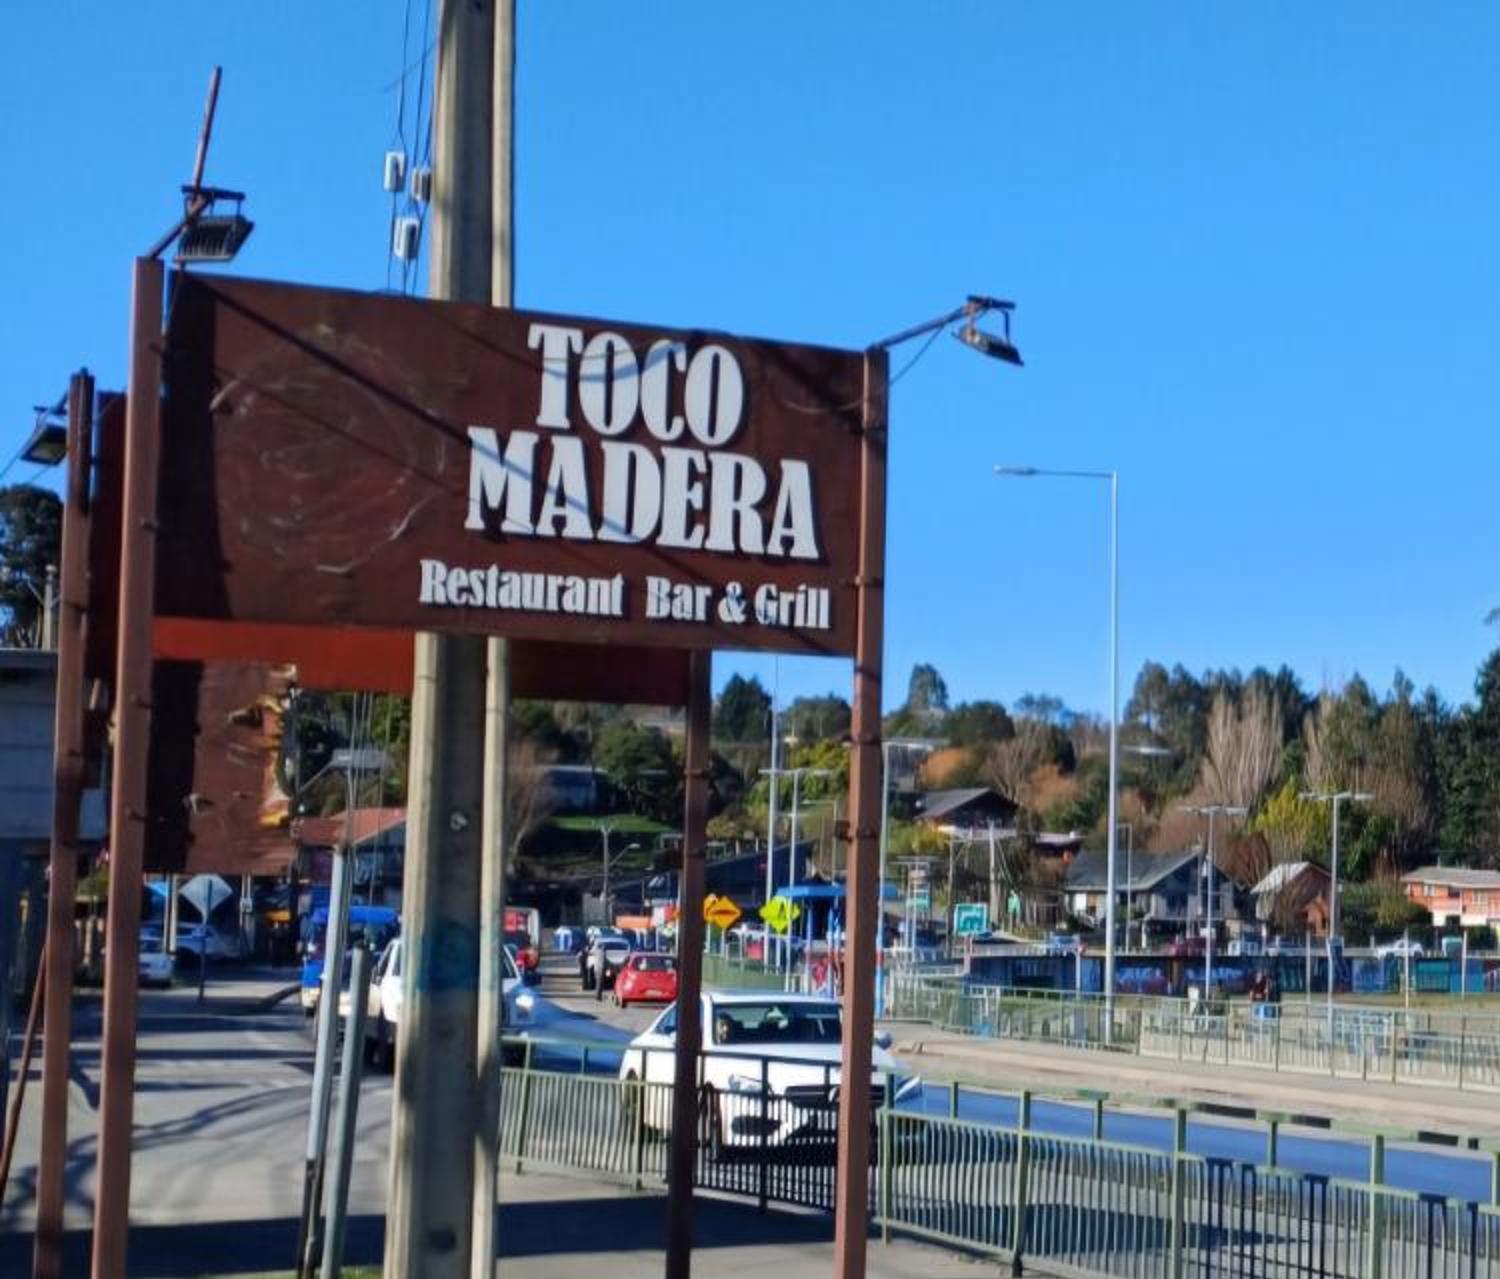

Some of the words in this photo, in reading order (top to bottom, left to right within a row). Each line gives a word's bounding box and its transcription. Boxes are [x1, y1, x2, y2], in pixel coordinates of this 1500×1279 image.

[529, 324, 744, 445] TOCO
[464, 427, 819, 559] MADERA
[420, 559, 624, 615] Restaurant
[646, 575, 710, 621] Bar
[719, 582, 746, 624] &
[756, 584, 829, 628] Grill
